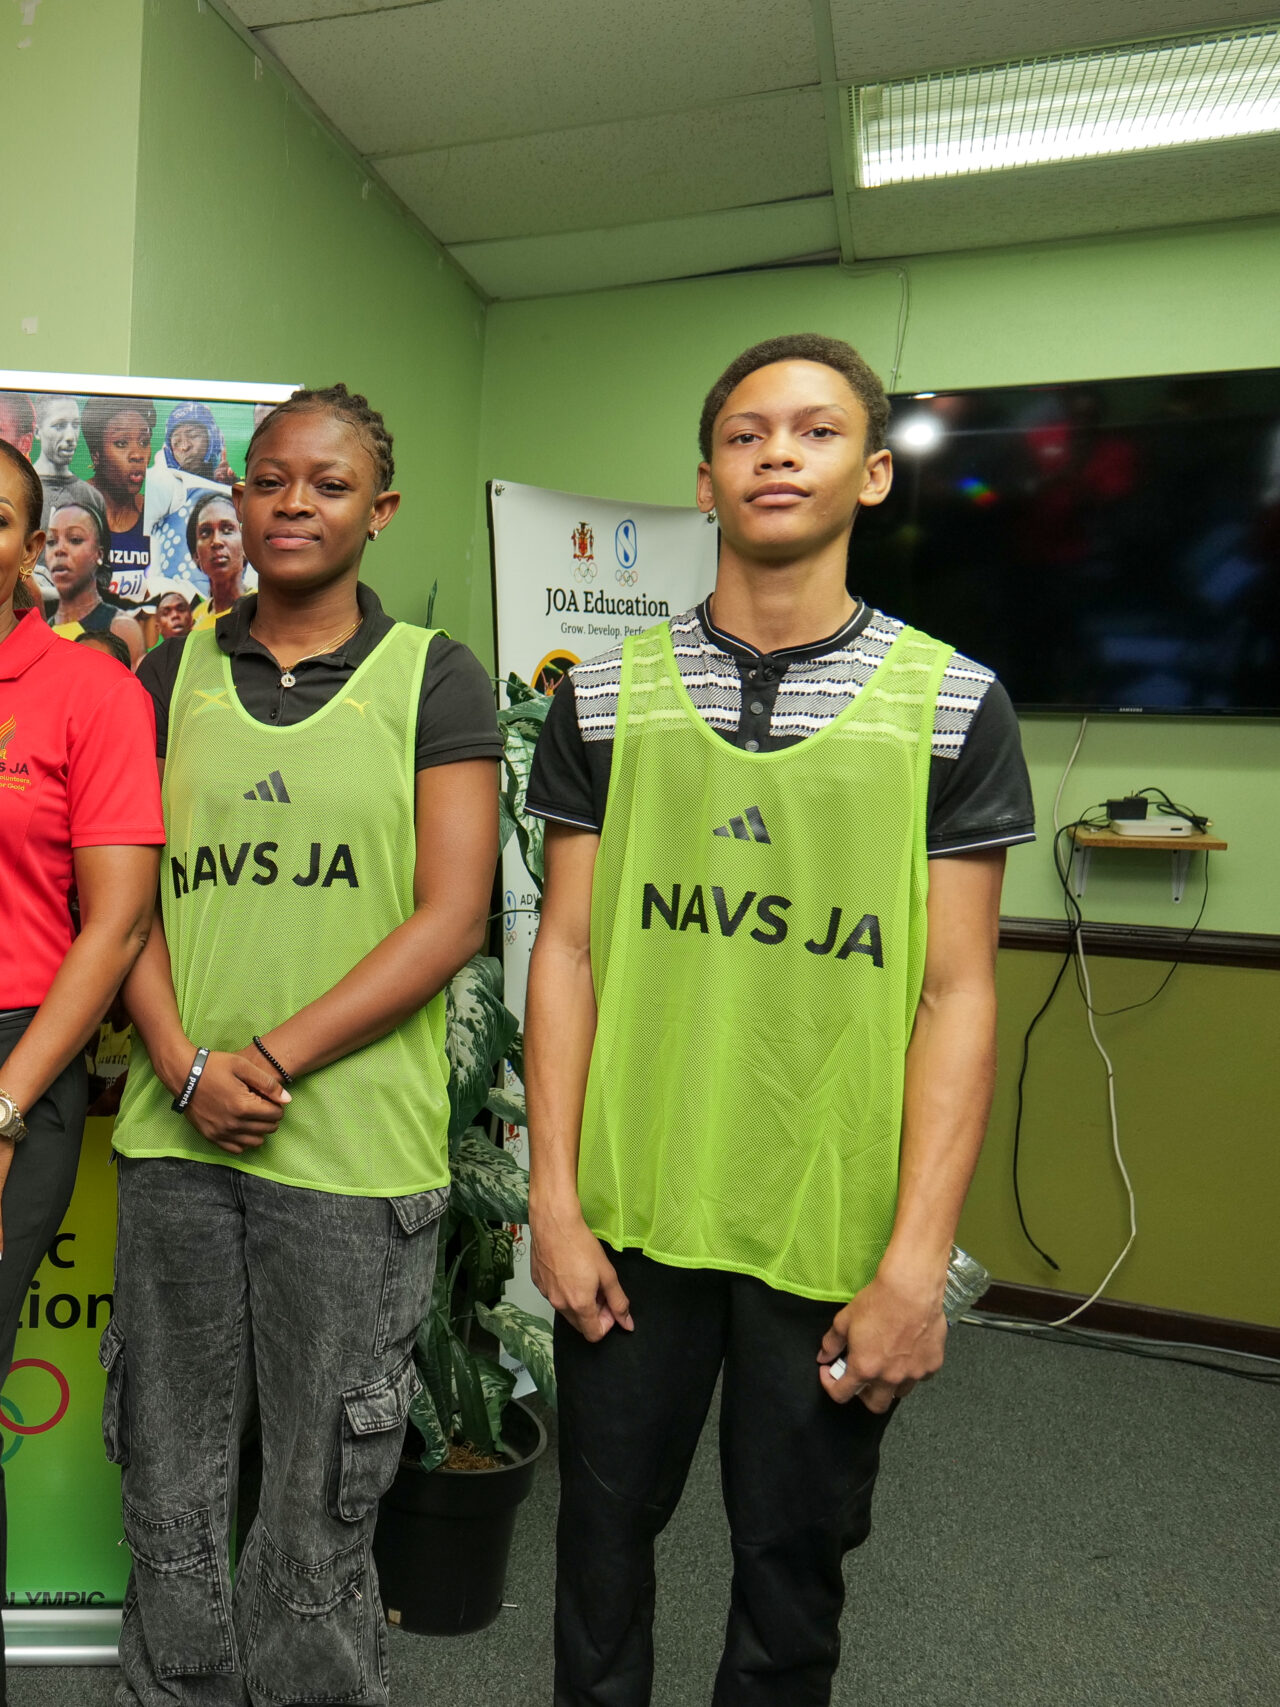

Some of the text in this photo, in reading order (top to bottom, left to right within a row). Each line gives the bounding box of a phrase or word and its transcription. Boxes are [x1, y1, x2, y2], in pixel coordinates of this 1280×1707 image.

[110, 550, 149, 565] IZUNO
[545, 587, 670, 617] JOA Education
[561, 622, 585, 634] Grow.
[588, 623, 622, 639] Develop.
[10, 762, 29, 775] JA
[171, 841, 359, 899] NAVS JA
[642, 883, 885, 969] NAVS JA
[179, 1076, 197, 1109] proverbs
